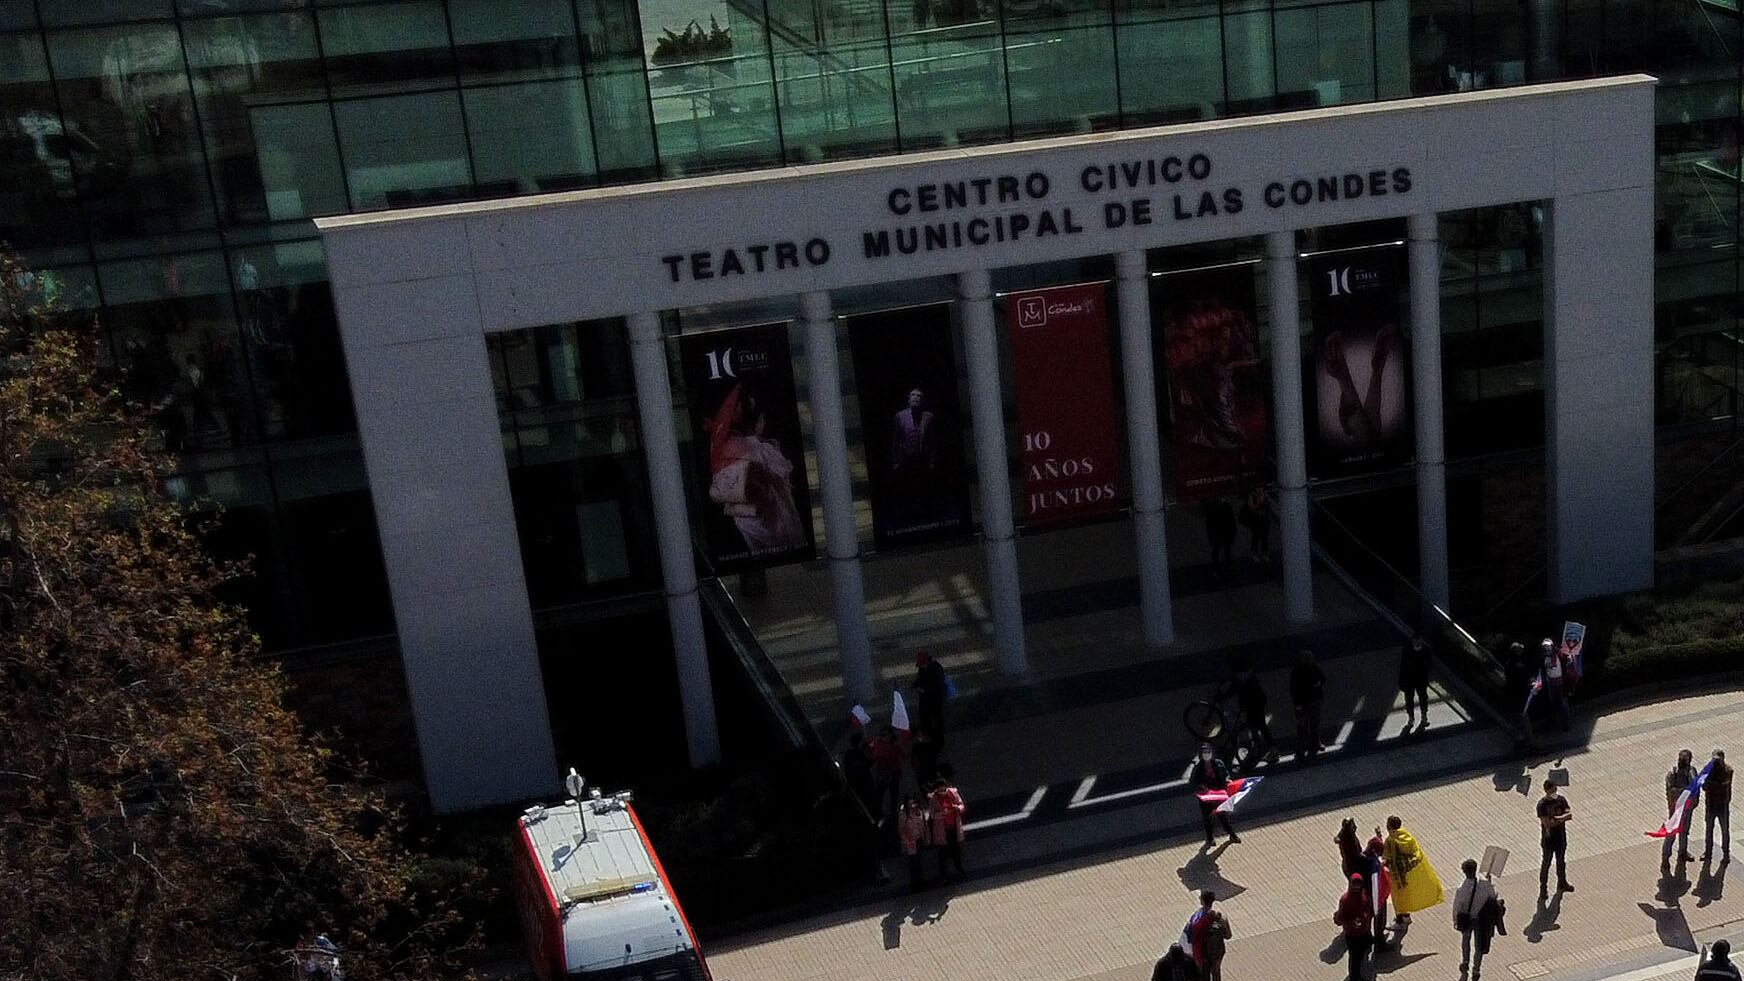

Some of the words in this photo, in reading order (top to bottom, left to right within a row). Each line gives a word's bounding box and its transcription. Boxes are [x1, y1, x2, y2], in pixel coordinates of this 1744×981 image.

[889, 170, 1051, 216] CENTRO
[1080, 153, 1212, 194] CIVICO
[663, 237, 832, 283] TEATRO
[864, 201, 1083, 259] MUNICIPAL
[1105, 200, 1151, 229] DE
[1174, 188, 1243, 219] LAS
[1265, 168, 1412, 208] CONDES
[1024, 432, 1051, 452] 10
[1029, 457, 1094, 481] AÑOS
[1030, 483, 1116, 514] JUNTOS
